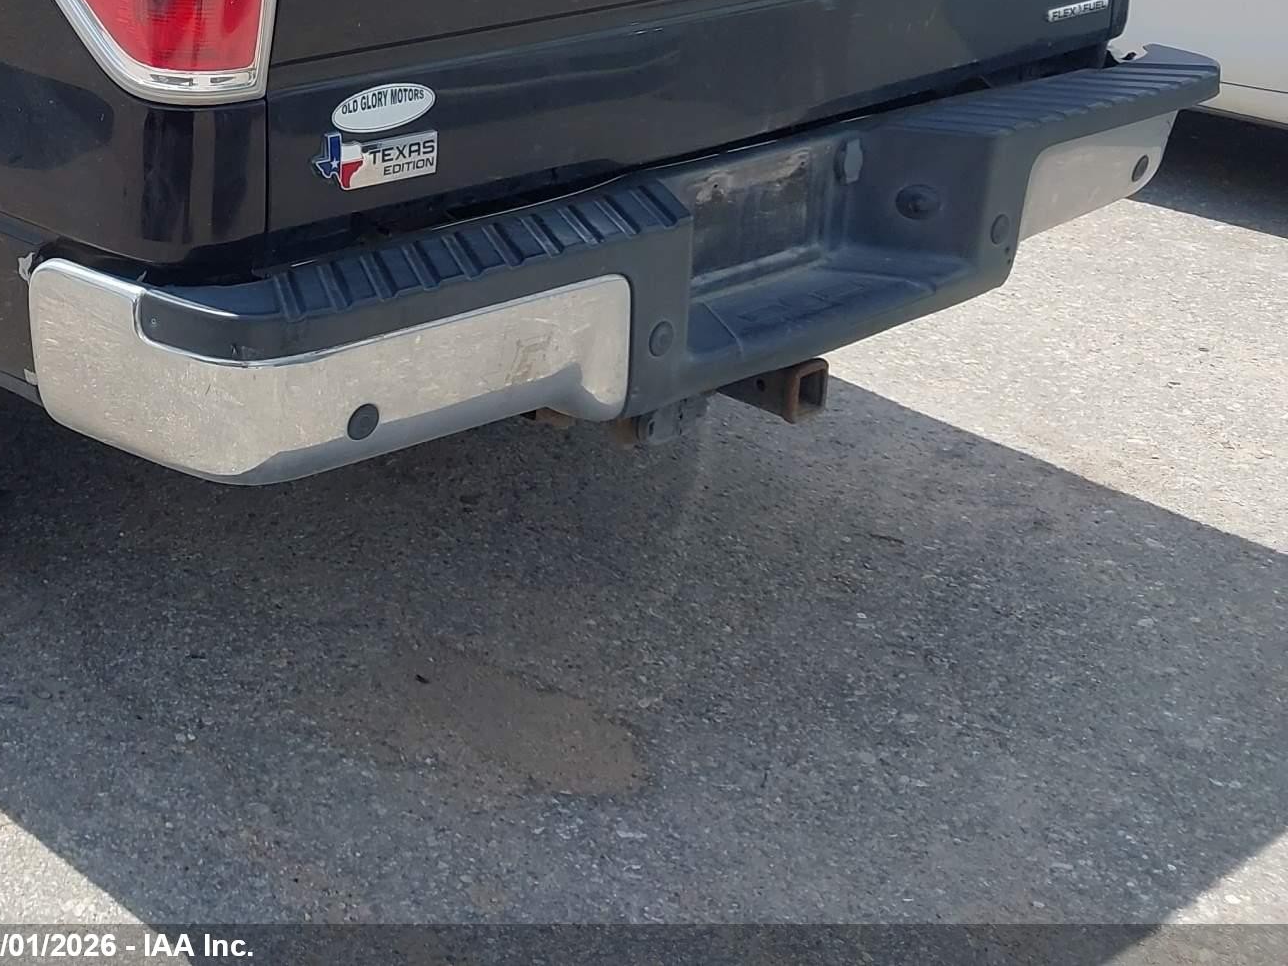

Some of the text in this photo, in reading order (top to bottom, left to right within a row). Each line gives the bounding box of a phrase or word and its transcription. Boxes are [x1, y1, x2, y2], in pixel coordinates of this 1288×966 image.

[341, 88, 425, 114] OLD GLORY MOTORS
[369, 140, 436, 165] TEXAS
[383, 157, 434, 176] EDITION
